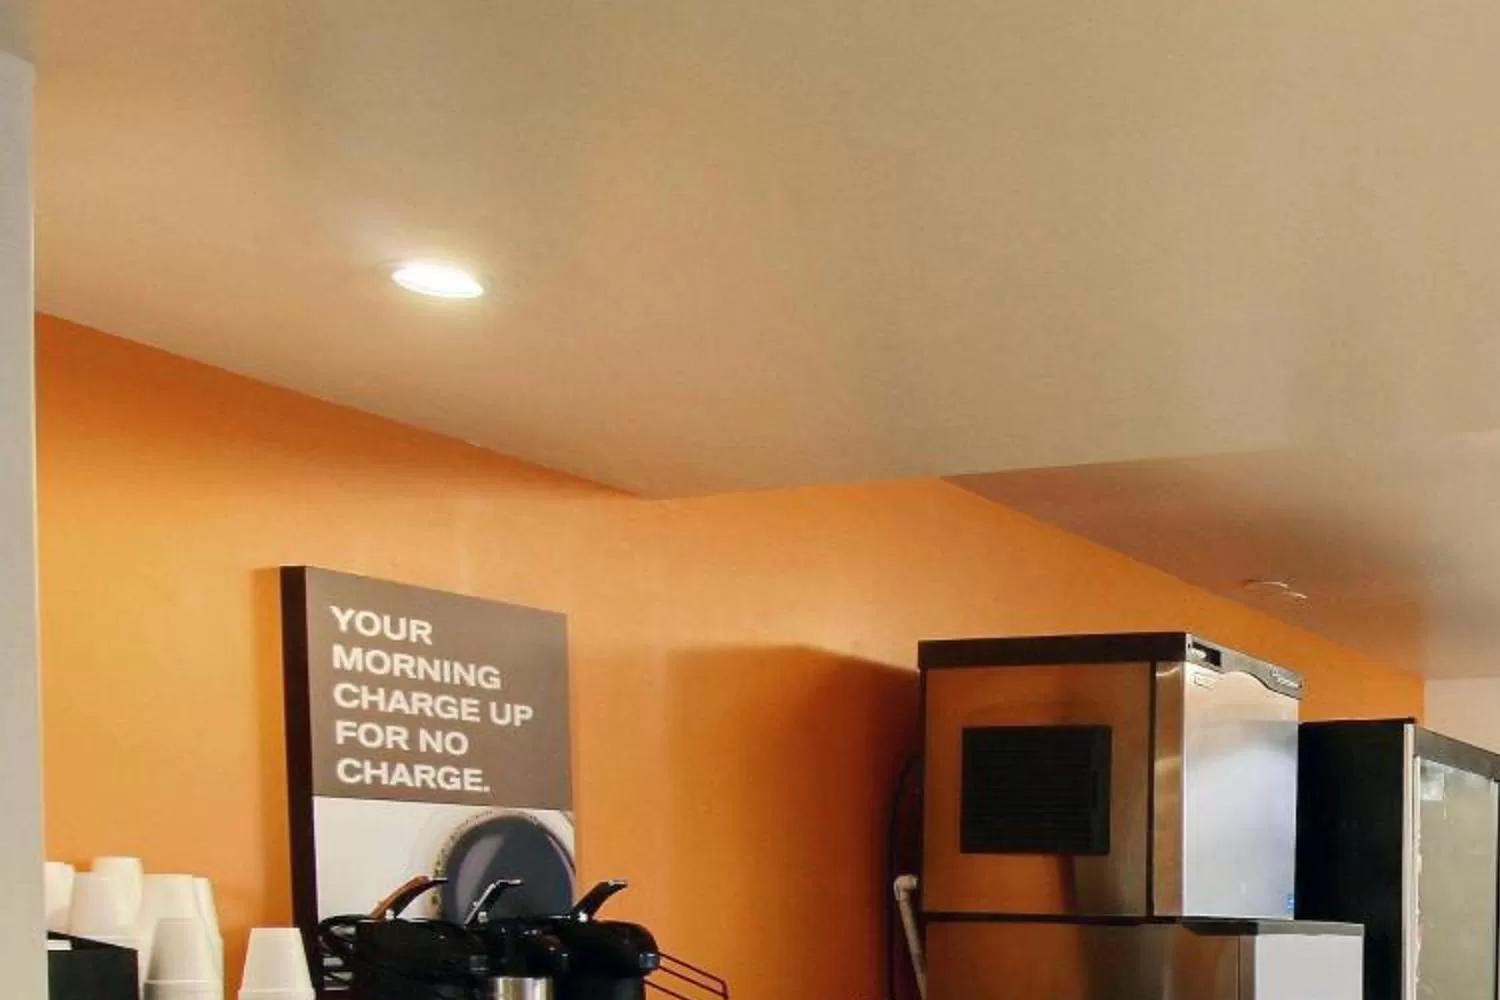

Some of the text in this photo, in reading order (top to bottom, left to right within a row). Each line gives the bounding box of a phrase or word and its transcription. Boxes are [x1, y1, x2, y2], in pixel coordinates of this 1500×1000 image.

[329, 605, 433, 645] YOUR
[331, 644, 502, 689] MORNING
[333, 683, 534, 727] CHARGE UP
[335, 720, 469, 756] FOR NO
[336, 758, 490, 792] CHARGE.
